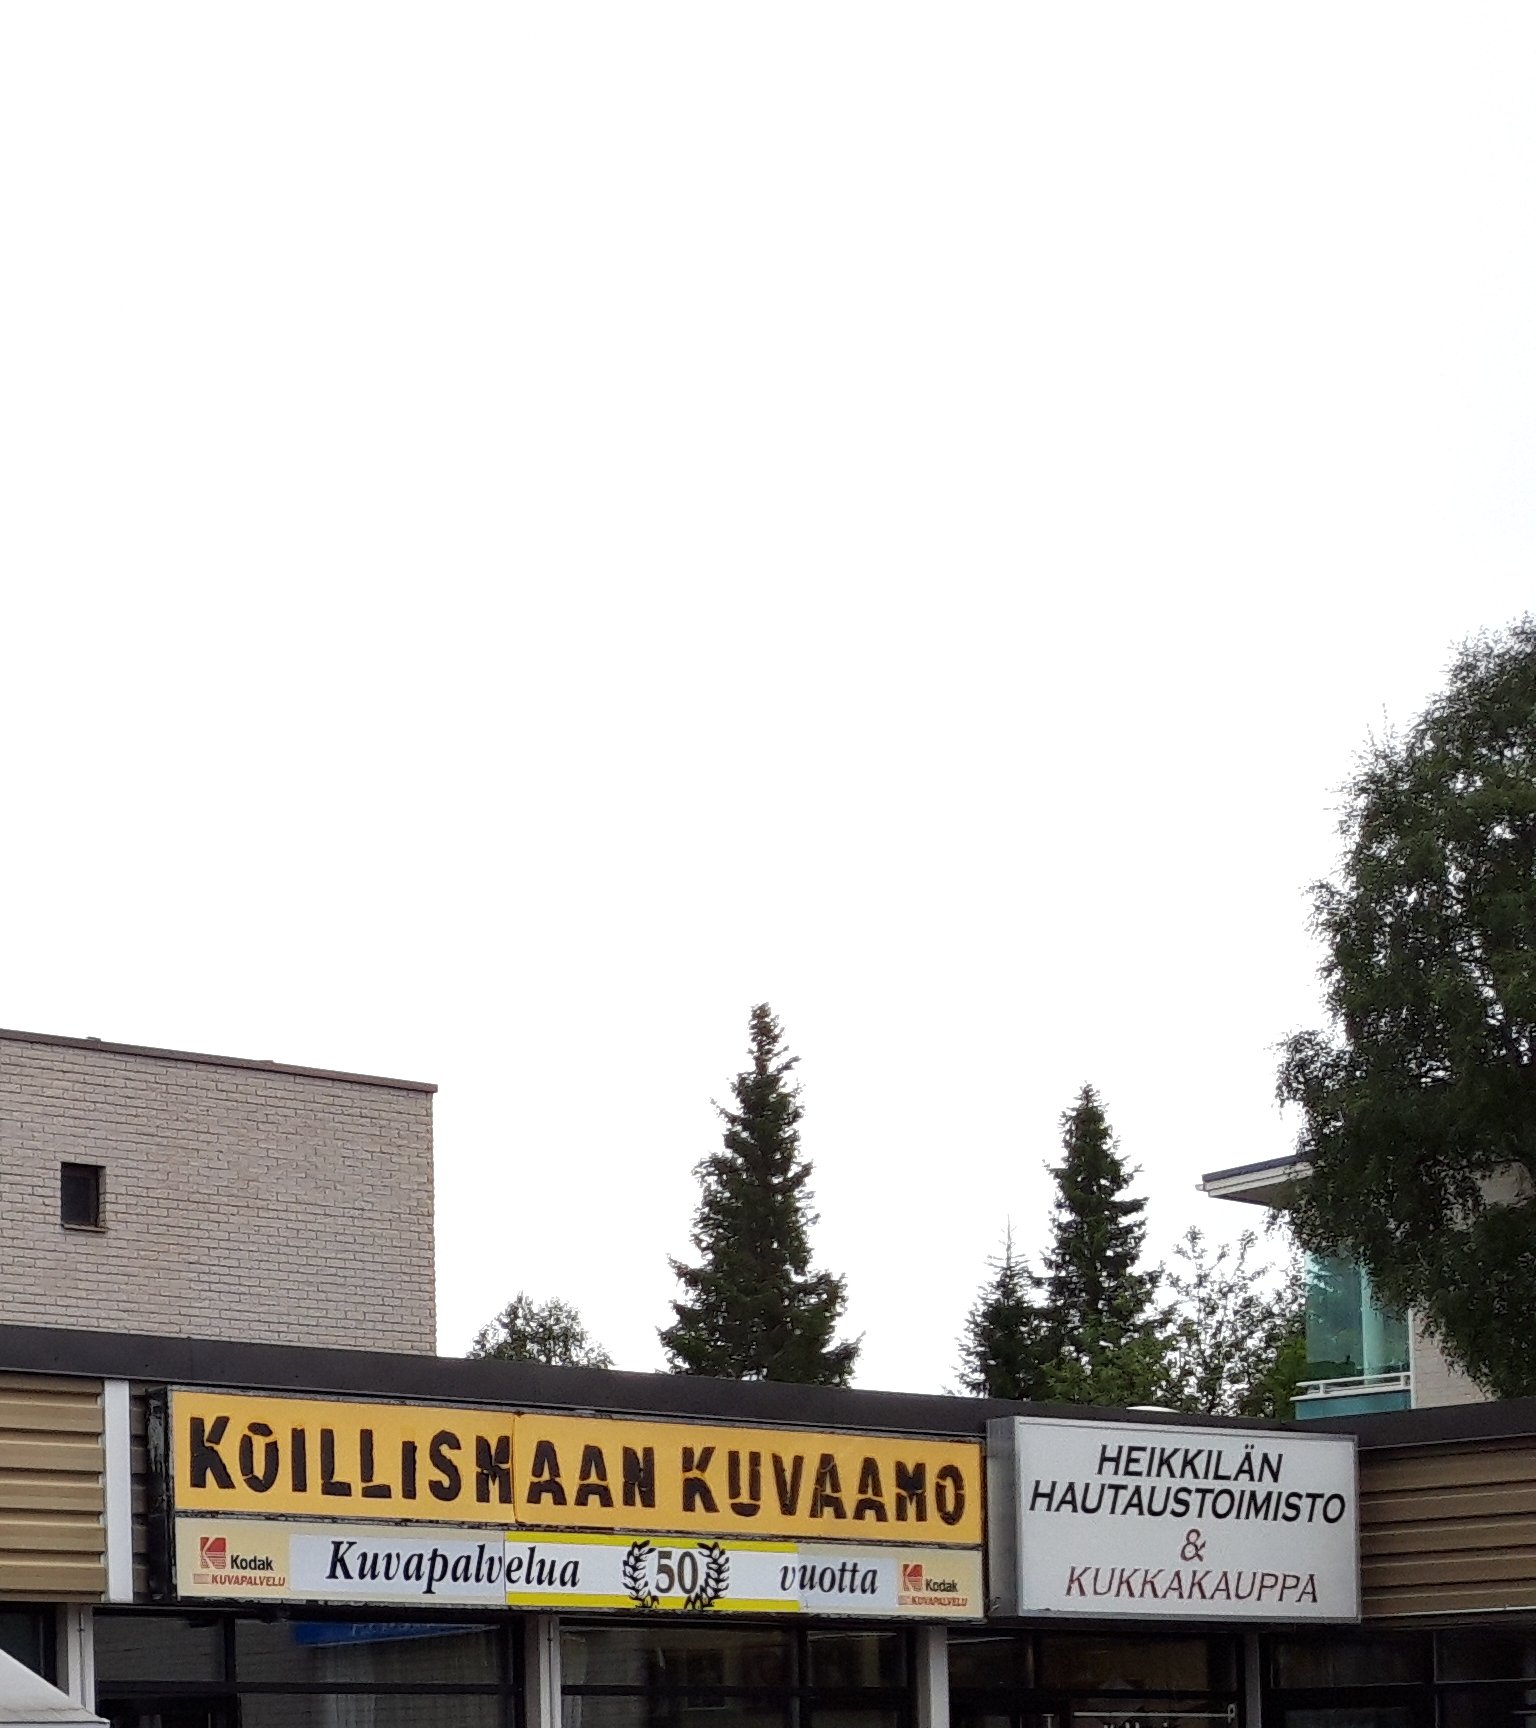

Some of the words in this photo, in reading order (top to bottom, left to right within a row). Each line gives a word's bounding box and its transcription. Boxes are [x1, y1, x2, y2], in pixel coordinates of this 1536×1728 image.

[189, 1414, 656, 1510] KOILLISMAAN
[681, 1445, 965, 1526] KUVAAMO
[1096, 1443, 1284, 1484] HEIKKILÄN
[1028, 1479, 1346, 1524] HAUTAUSTOIMISTO
[230, 1554, 274, 1571] Kodak
[1180, 1528, 1207, 1562] &
[211, 1574, 286, 1587] KUVAPALVELU
[325, 1539, 581, 1595] Kuvapalvelua
[654, 1549, 699, 1596] 50
[779, 1560, 879, 1596] vuotta
[925, 1578, 959, 1593] Kodak
[1064, 1565, 1319, 1603] KUKKAKAUPPA
